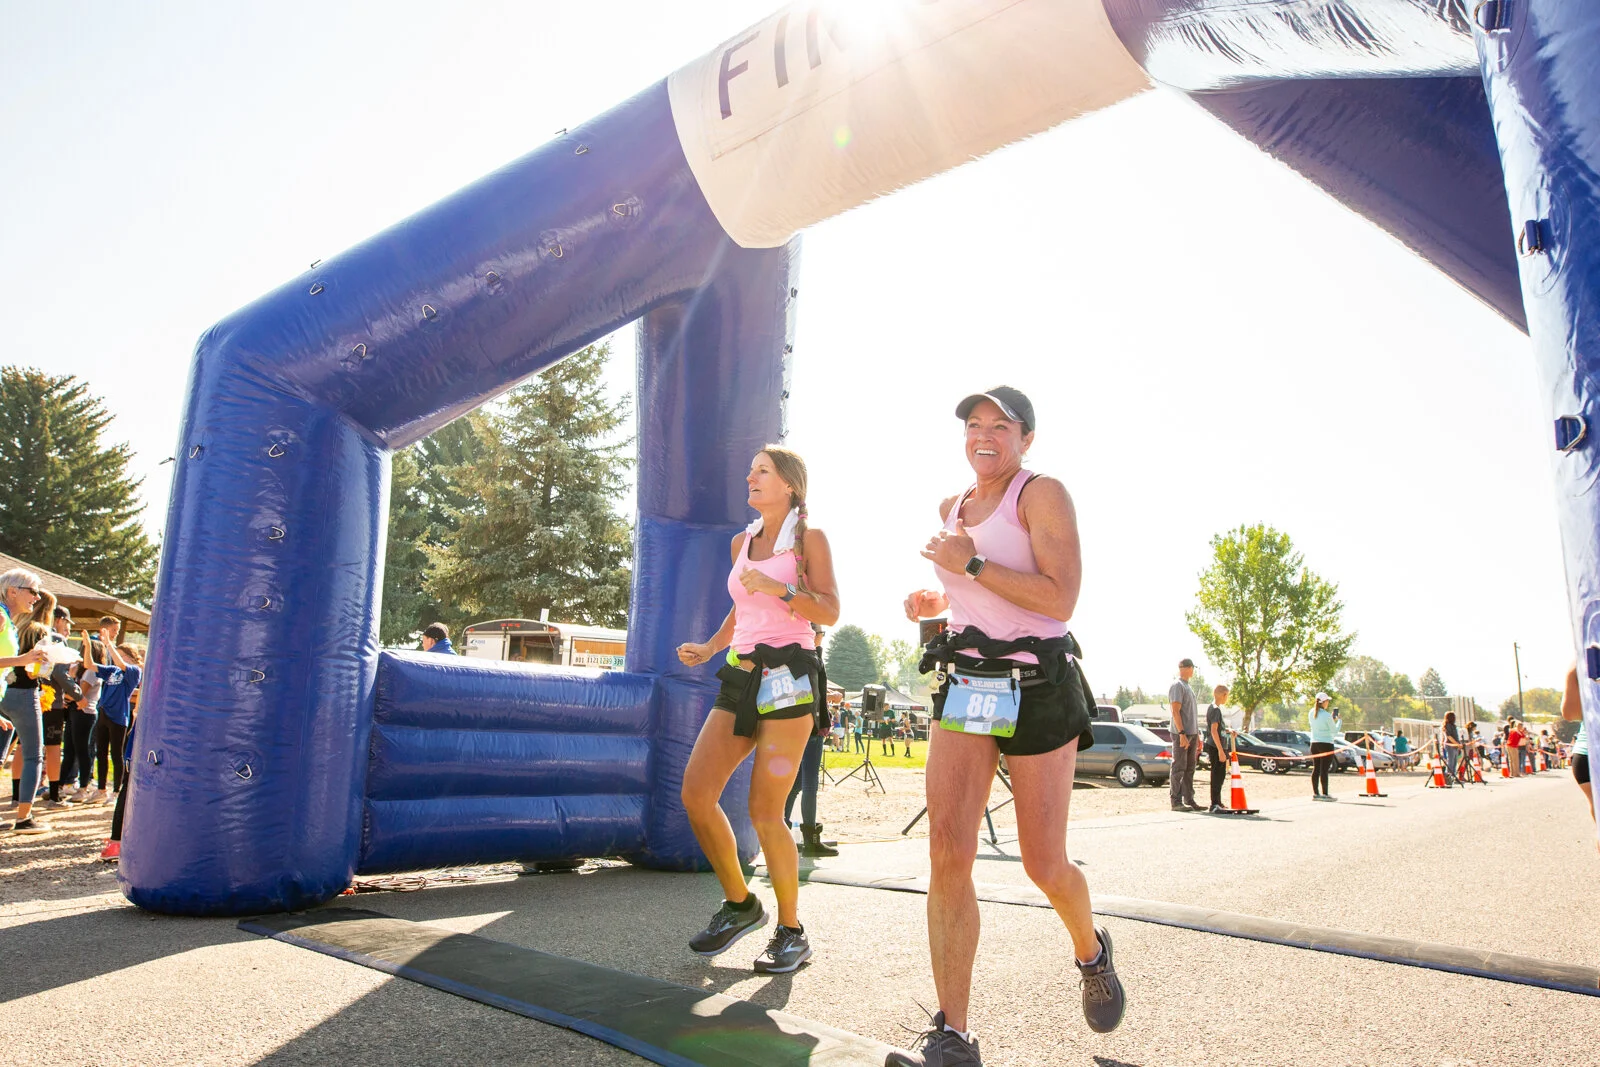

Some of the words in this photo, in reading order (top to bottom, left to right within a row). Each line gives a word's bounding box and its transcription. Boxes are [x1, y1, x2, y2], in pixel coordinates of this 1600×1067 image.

[772, 676, 794, 697] 88
[971, 680, 1008, 689] BEAVER
[966, 693, 998, 718] 86
